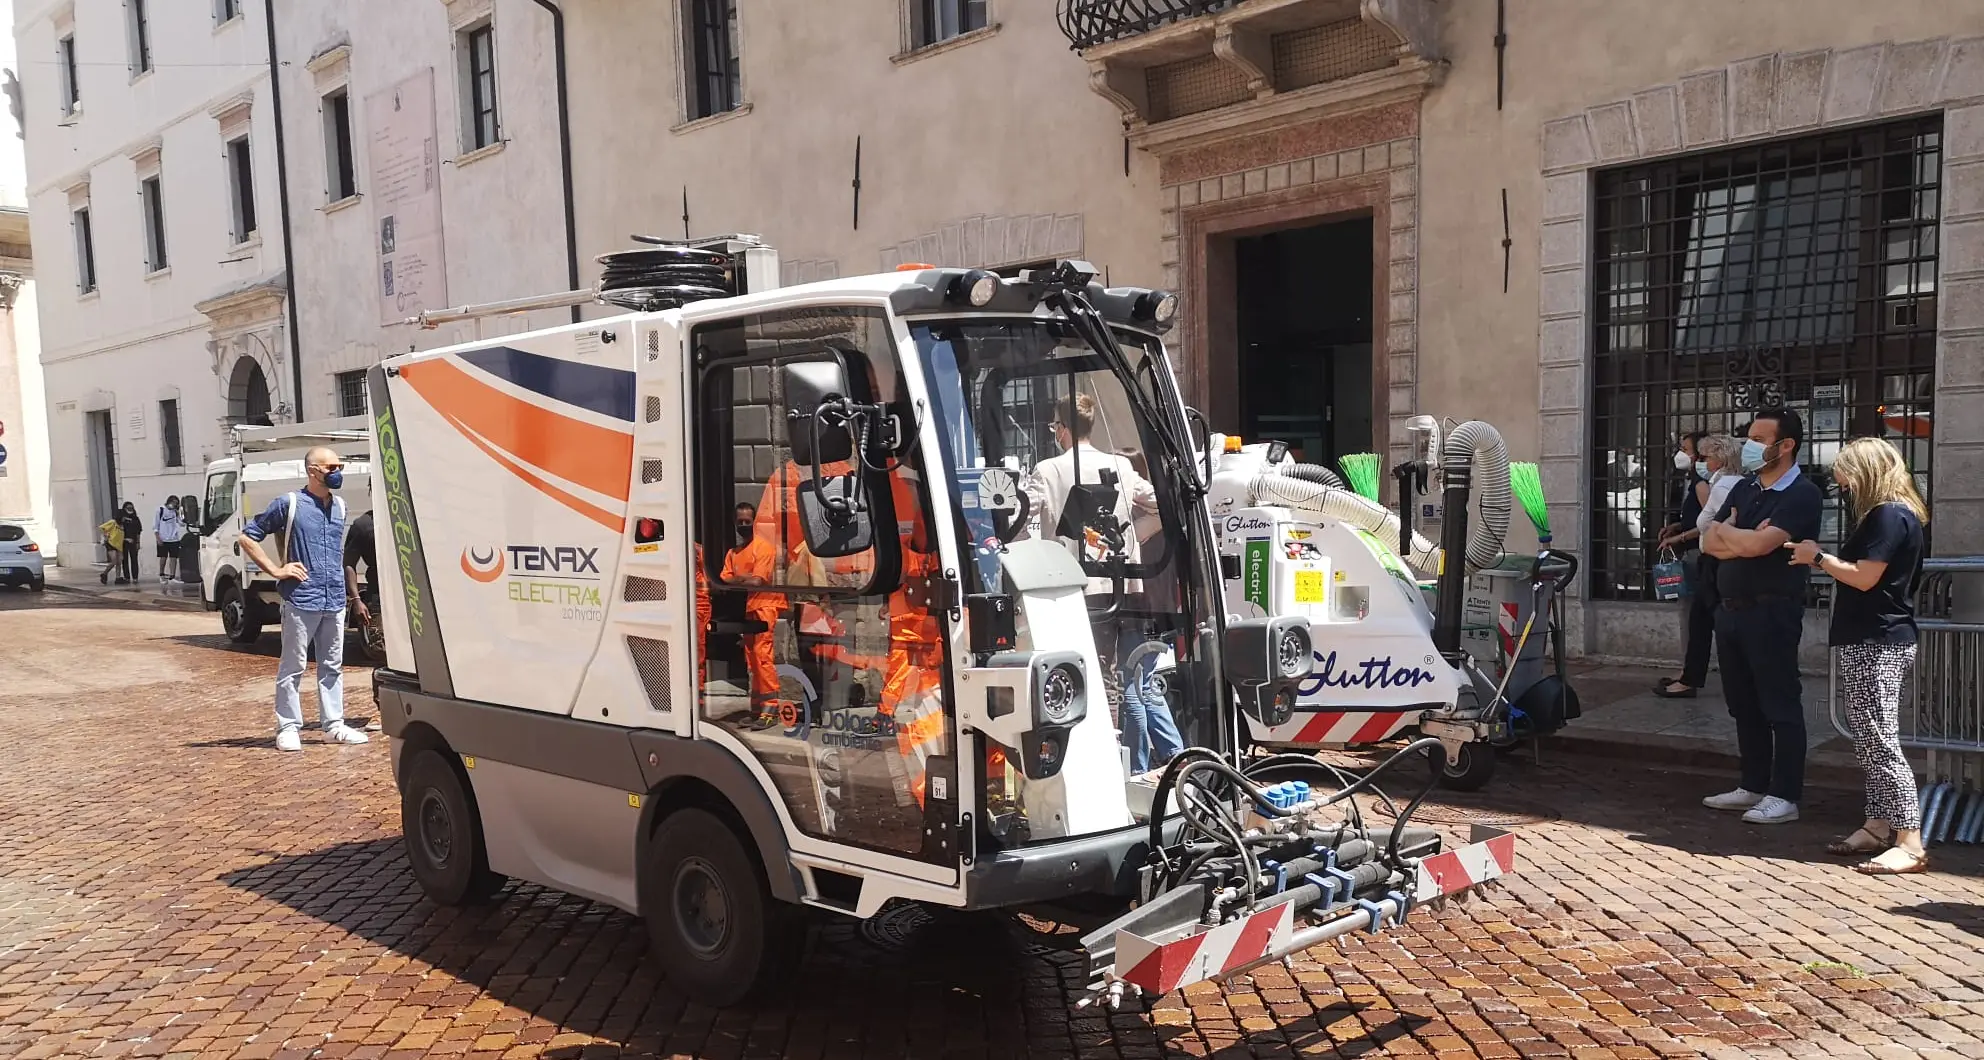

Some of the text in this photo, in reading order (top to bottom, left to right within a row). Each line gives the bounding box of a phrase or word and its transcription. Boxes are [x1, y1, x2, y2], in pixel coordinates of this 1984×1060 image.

[1226, 516, 1271, 532] Glutton
[507, 545, 600, 573] TENAX
[395, 514, 423, 637] Electric
[1251, 549, 1263, 603] electric
[508, 582, 601, 607] ELECTRA
[574, 606, 602, 624] hydro
[1297, 651, 1435, 696] Glutton
